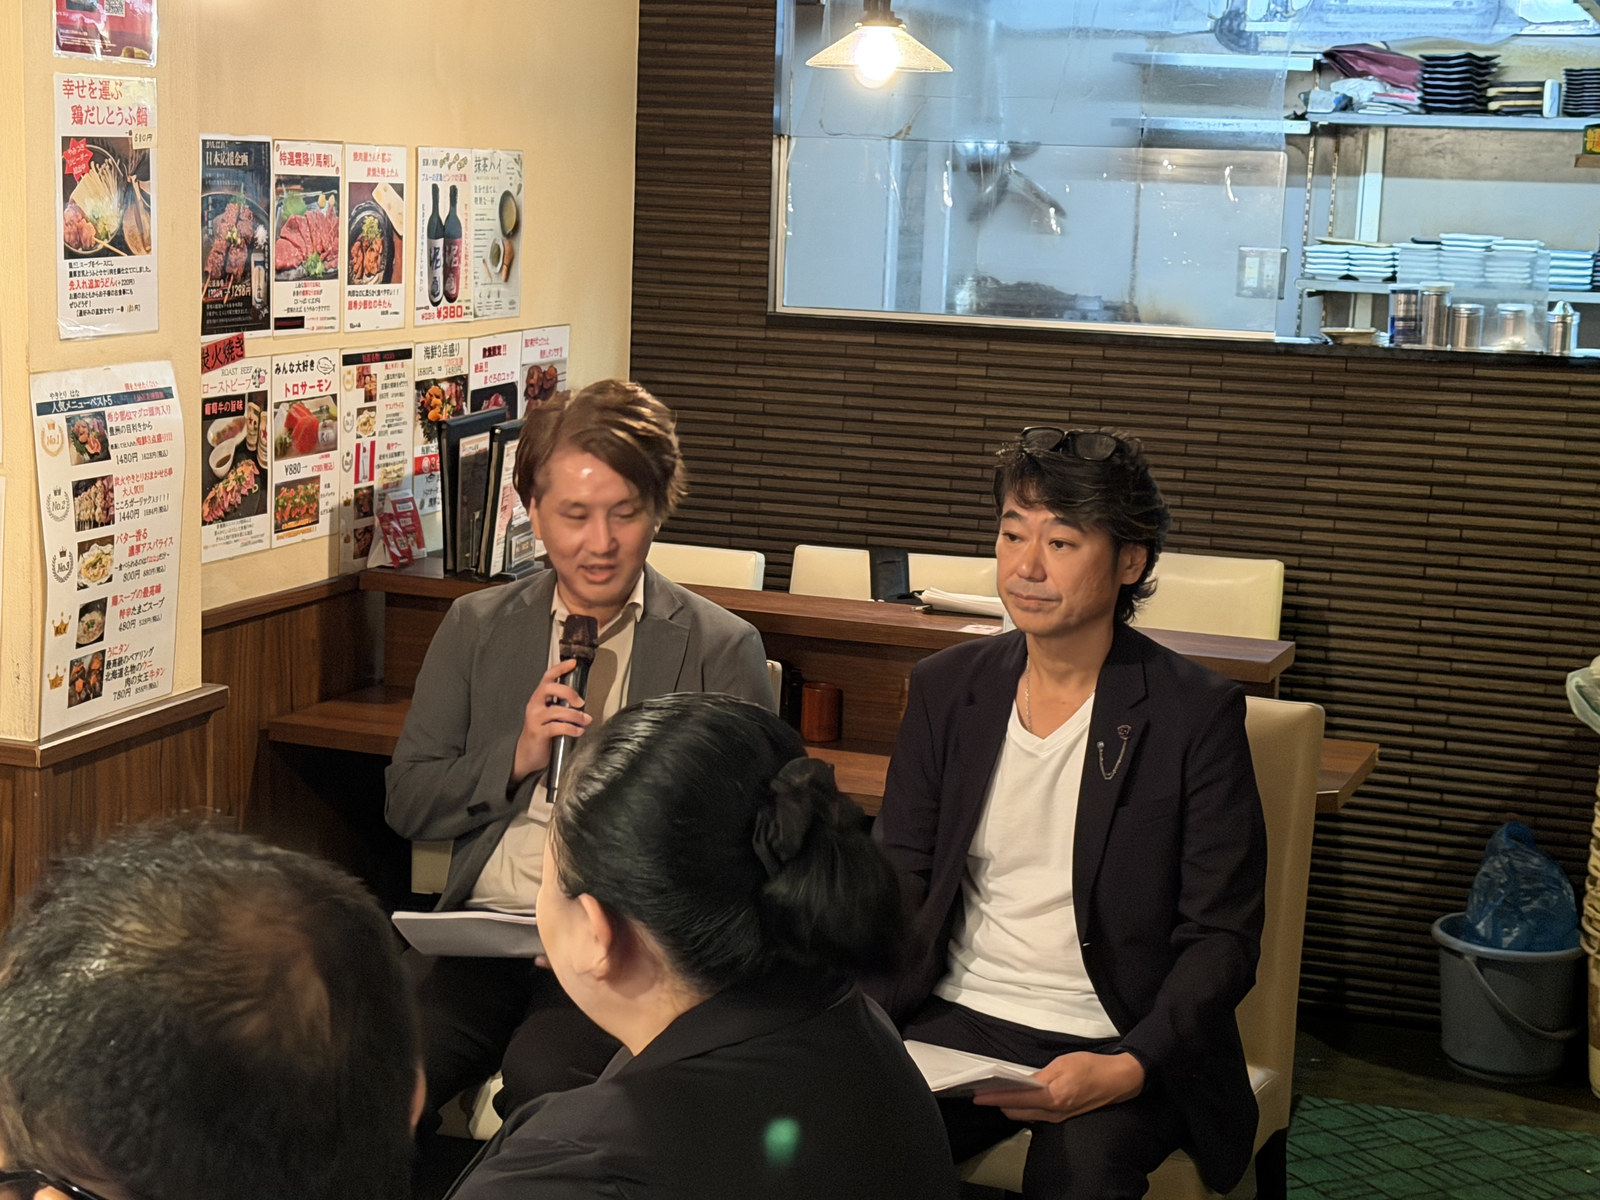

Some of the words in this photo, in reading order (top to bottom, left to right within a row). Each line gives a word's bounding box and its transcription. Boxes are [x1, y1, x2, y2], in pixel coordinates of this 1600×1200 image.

[62, 78, 123, 100] 幸せを運ぶ
[71, 104, 148, 127] 鶏だしとうふ鍋
[206, 151, 249, 166] 日本応援企画
[279, 151, 337, 168] 特選霜降り馬刺し
[436, 305, 463, 319] ¥380
[424, 343, 460, 360] 海鮮3点盛り
[275, 359, 315, 375] みんな大好き
[202, 378, 252, 394] ローストビーフ
[284, 379, 332, 397] トロサーモン
[51, 395, 113, 414] 人気メニューベスト5
[115, 452, 138, 465] 1480円
[284, 462, 301, 476] ¥880
[52, 500, 66, 512] No.2
[118, 509, 140, 522] 1440円
[115, 528, 148, 545] バター香る
[123, 569, 140, 582] 800円
[118, 619, 137, 632] 480円
[124, 667, 165, 688] 肉の女王牛タン
[112, 688, 131, 701] 780円
